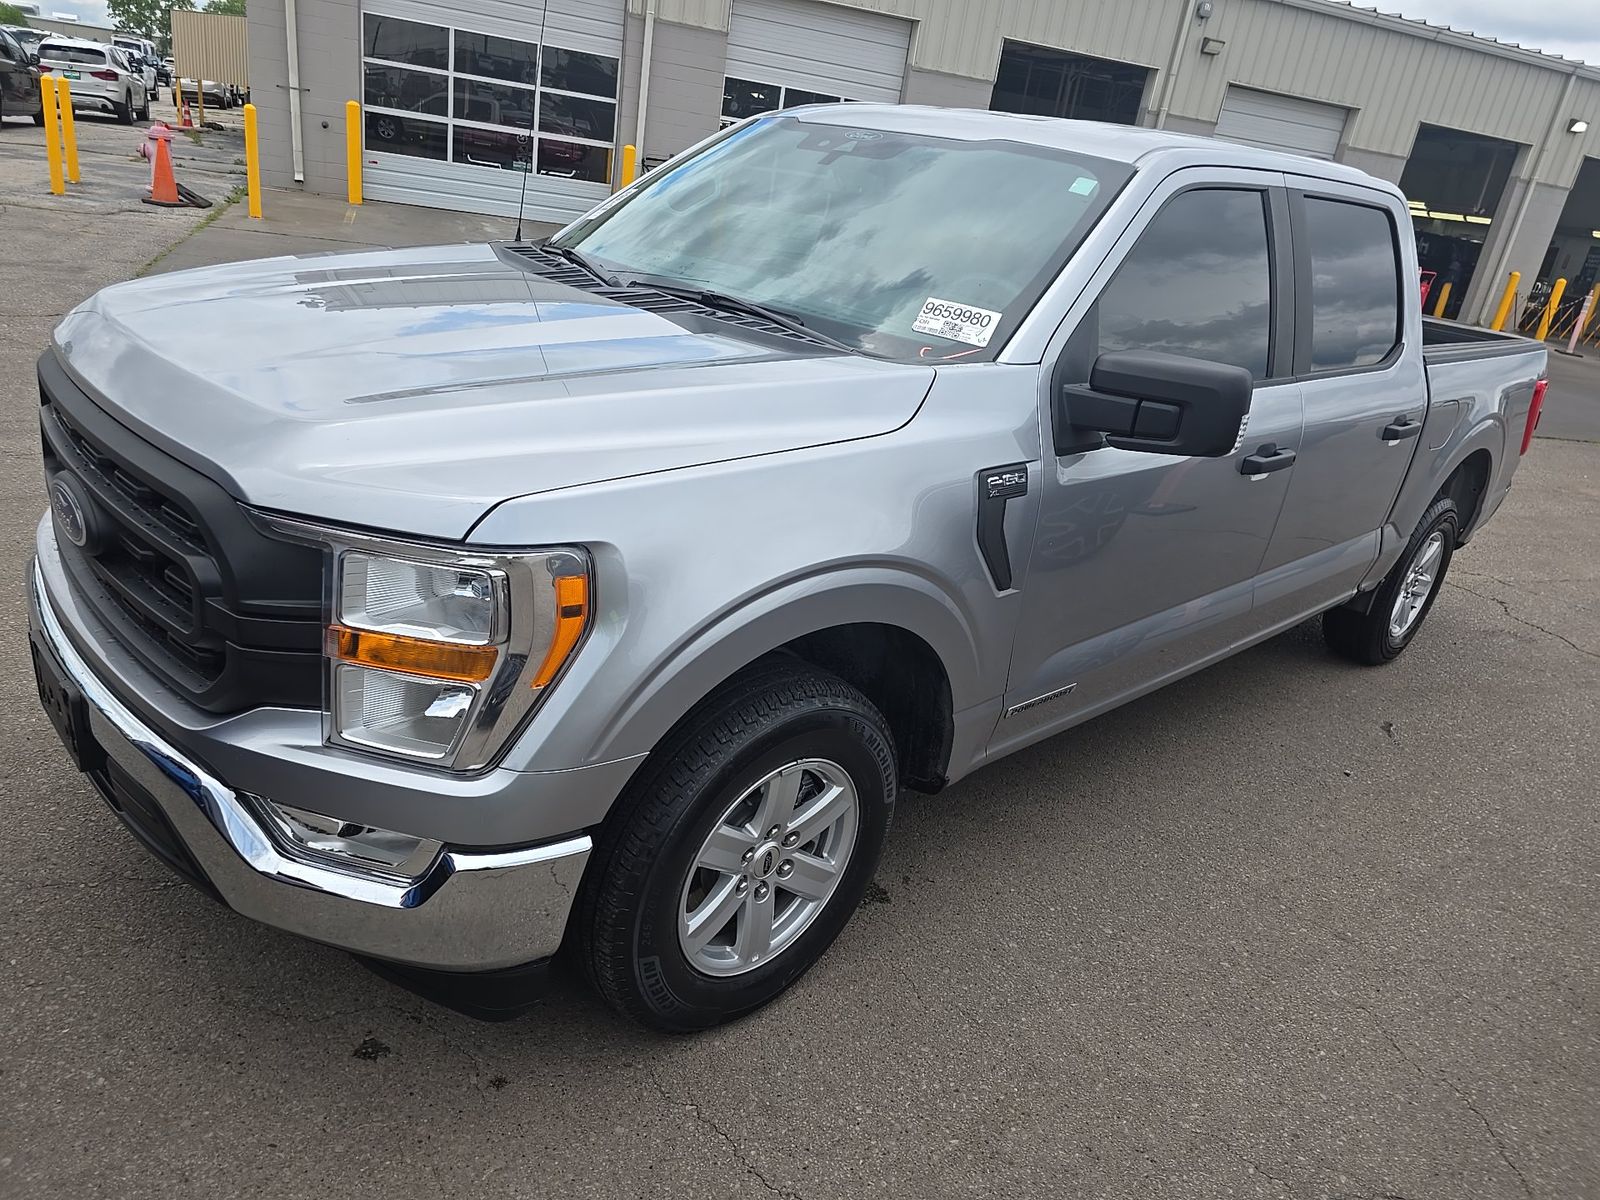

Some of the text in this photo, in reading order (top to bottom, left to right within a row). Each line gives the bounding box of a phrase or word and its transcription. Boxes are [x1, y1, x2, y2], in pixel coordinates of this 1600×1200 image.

[923, 301, 992, 328] 9659980
[987, 472, 1027, 488] F-150
[989, 490, 1000, 498] XL
[865, 733, 894, 799] MICHELIN
